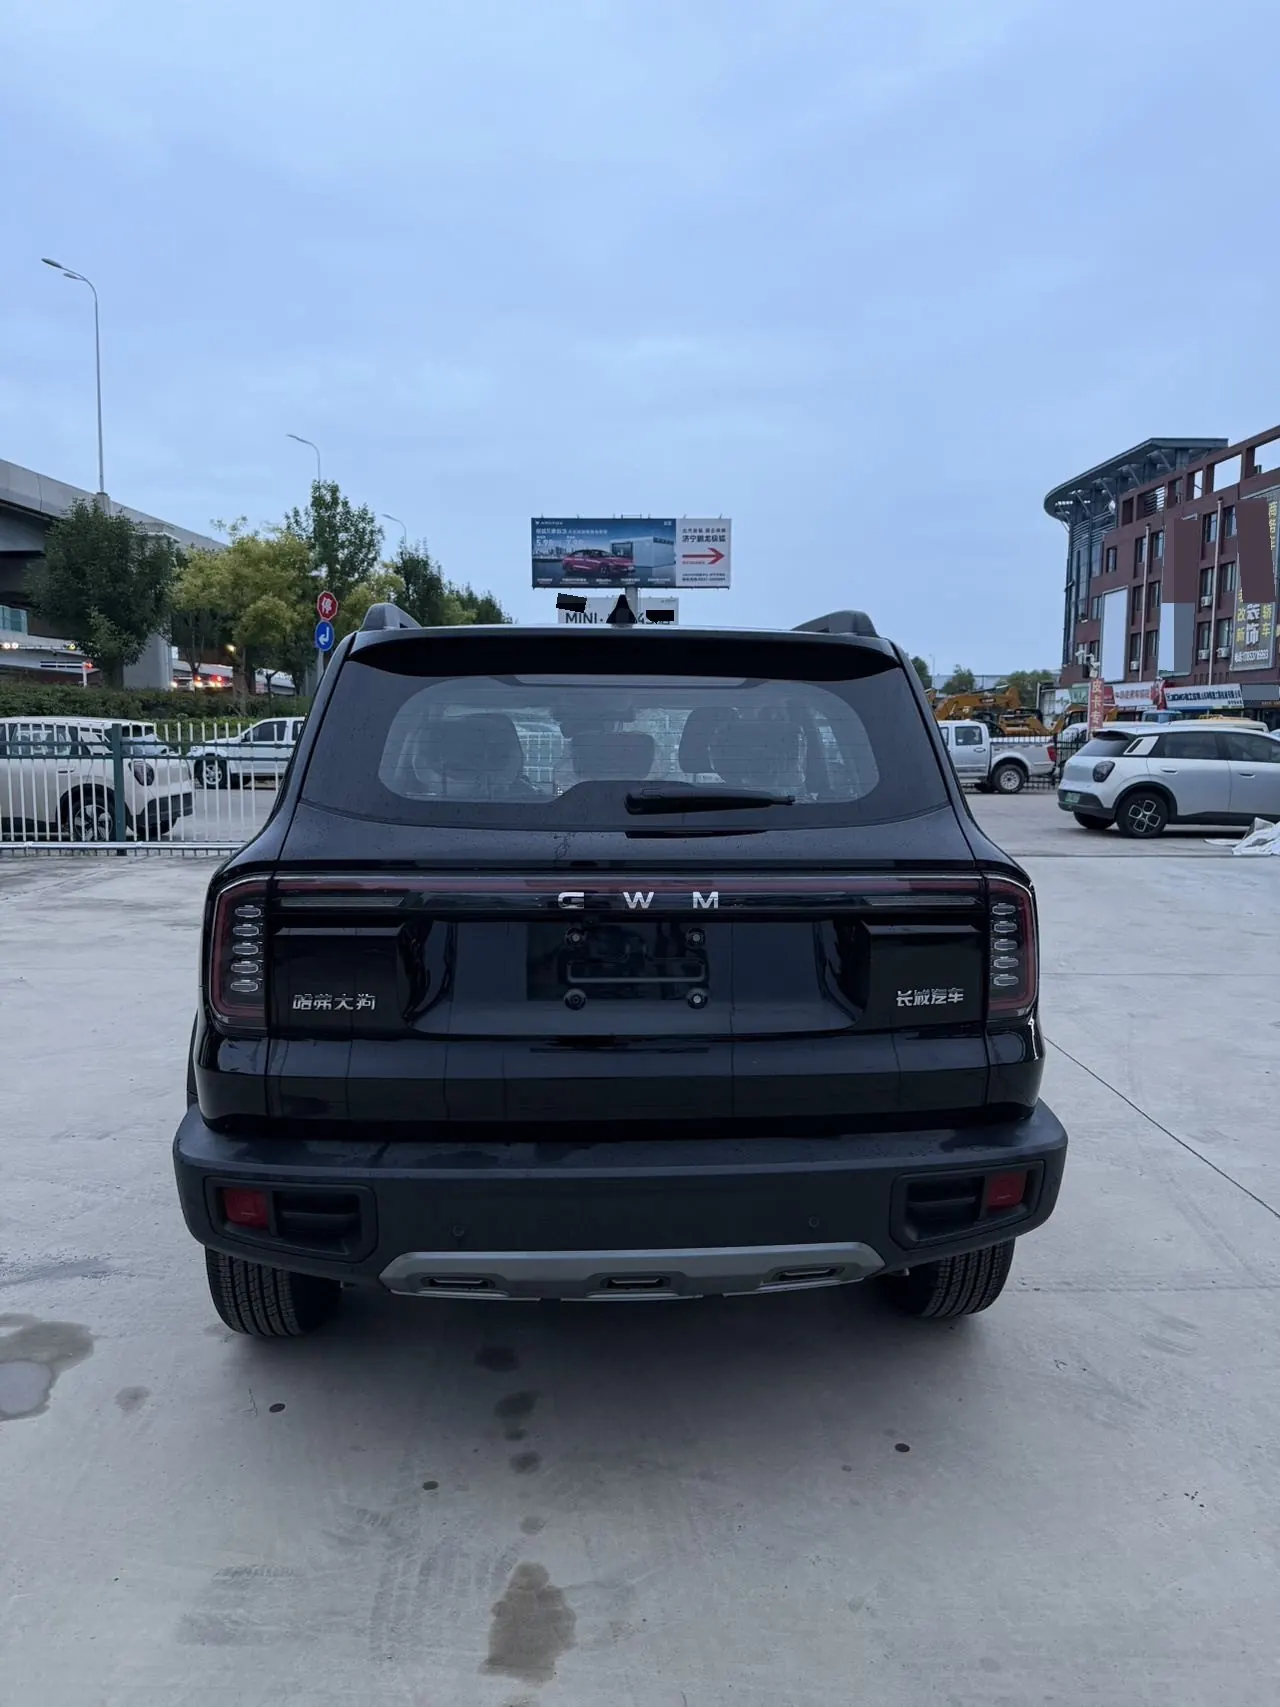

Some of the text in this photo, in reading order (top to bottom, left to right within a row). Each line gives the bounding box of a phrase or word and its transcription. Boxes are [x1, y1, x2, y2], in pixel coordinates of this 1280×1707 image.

[1090, 680, 1102, 729] 皮卡专
[557, 891, 719, 909] GWM
[292, 993, 376, 1010] 哈弗大狗
[896, 987, 964, 1007] 长城汽车
